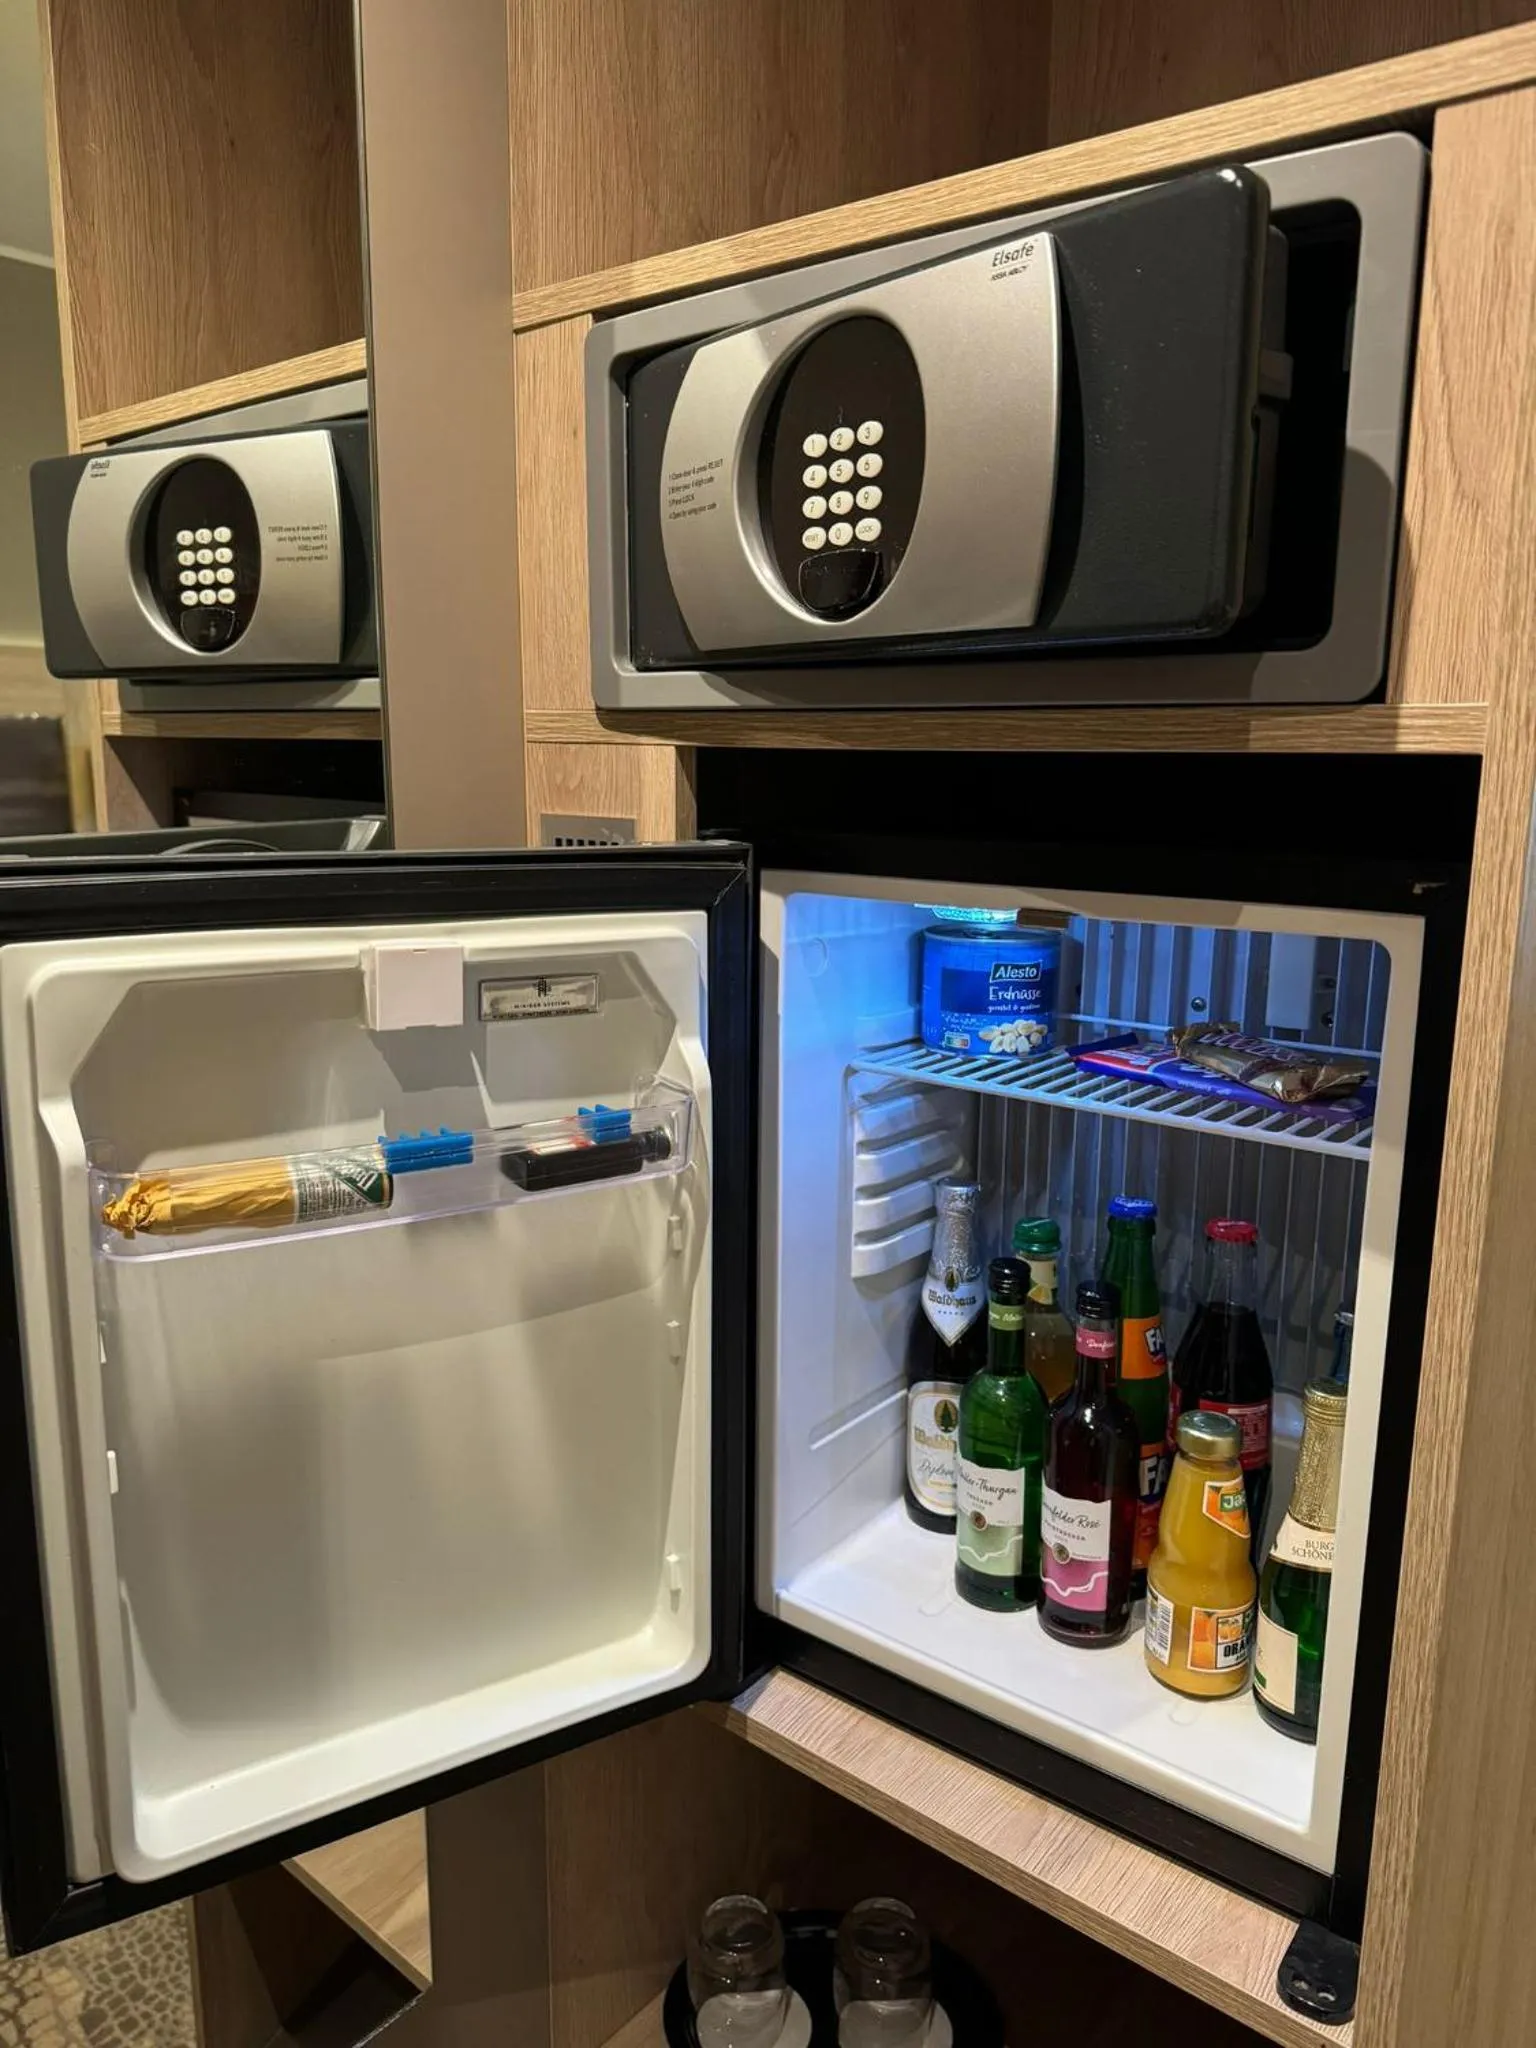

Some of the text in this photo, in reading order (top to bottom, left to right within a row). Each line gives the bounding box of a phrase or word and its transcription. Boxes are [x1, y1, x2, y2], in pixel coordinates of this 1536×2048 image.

[992, 242, 1034, 267] Elsafe
[836, 432, 843, 446] 2
[864, 427, 871, 440] 3
[836, 464, 843, 477] 5
[863, 460, 870, 472] 6
[809, 470, 816, 482] 4
[836, 496, 842, 509] 8
[864, 491, 870, 503] 9
[810, 501, 817, 513] 7
[834, 528, 842, 541] 0
[994, 965, 1037, 978] Alesto
